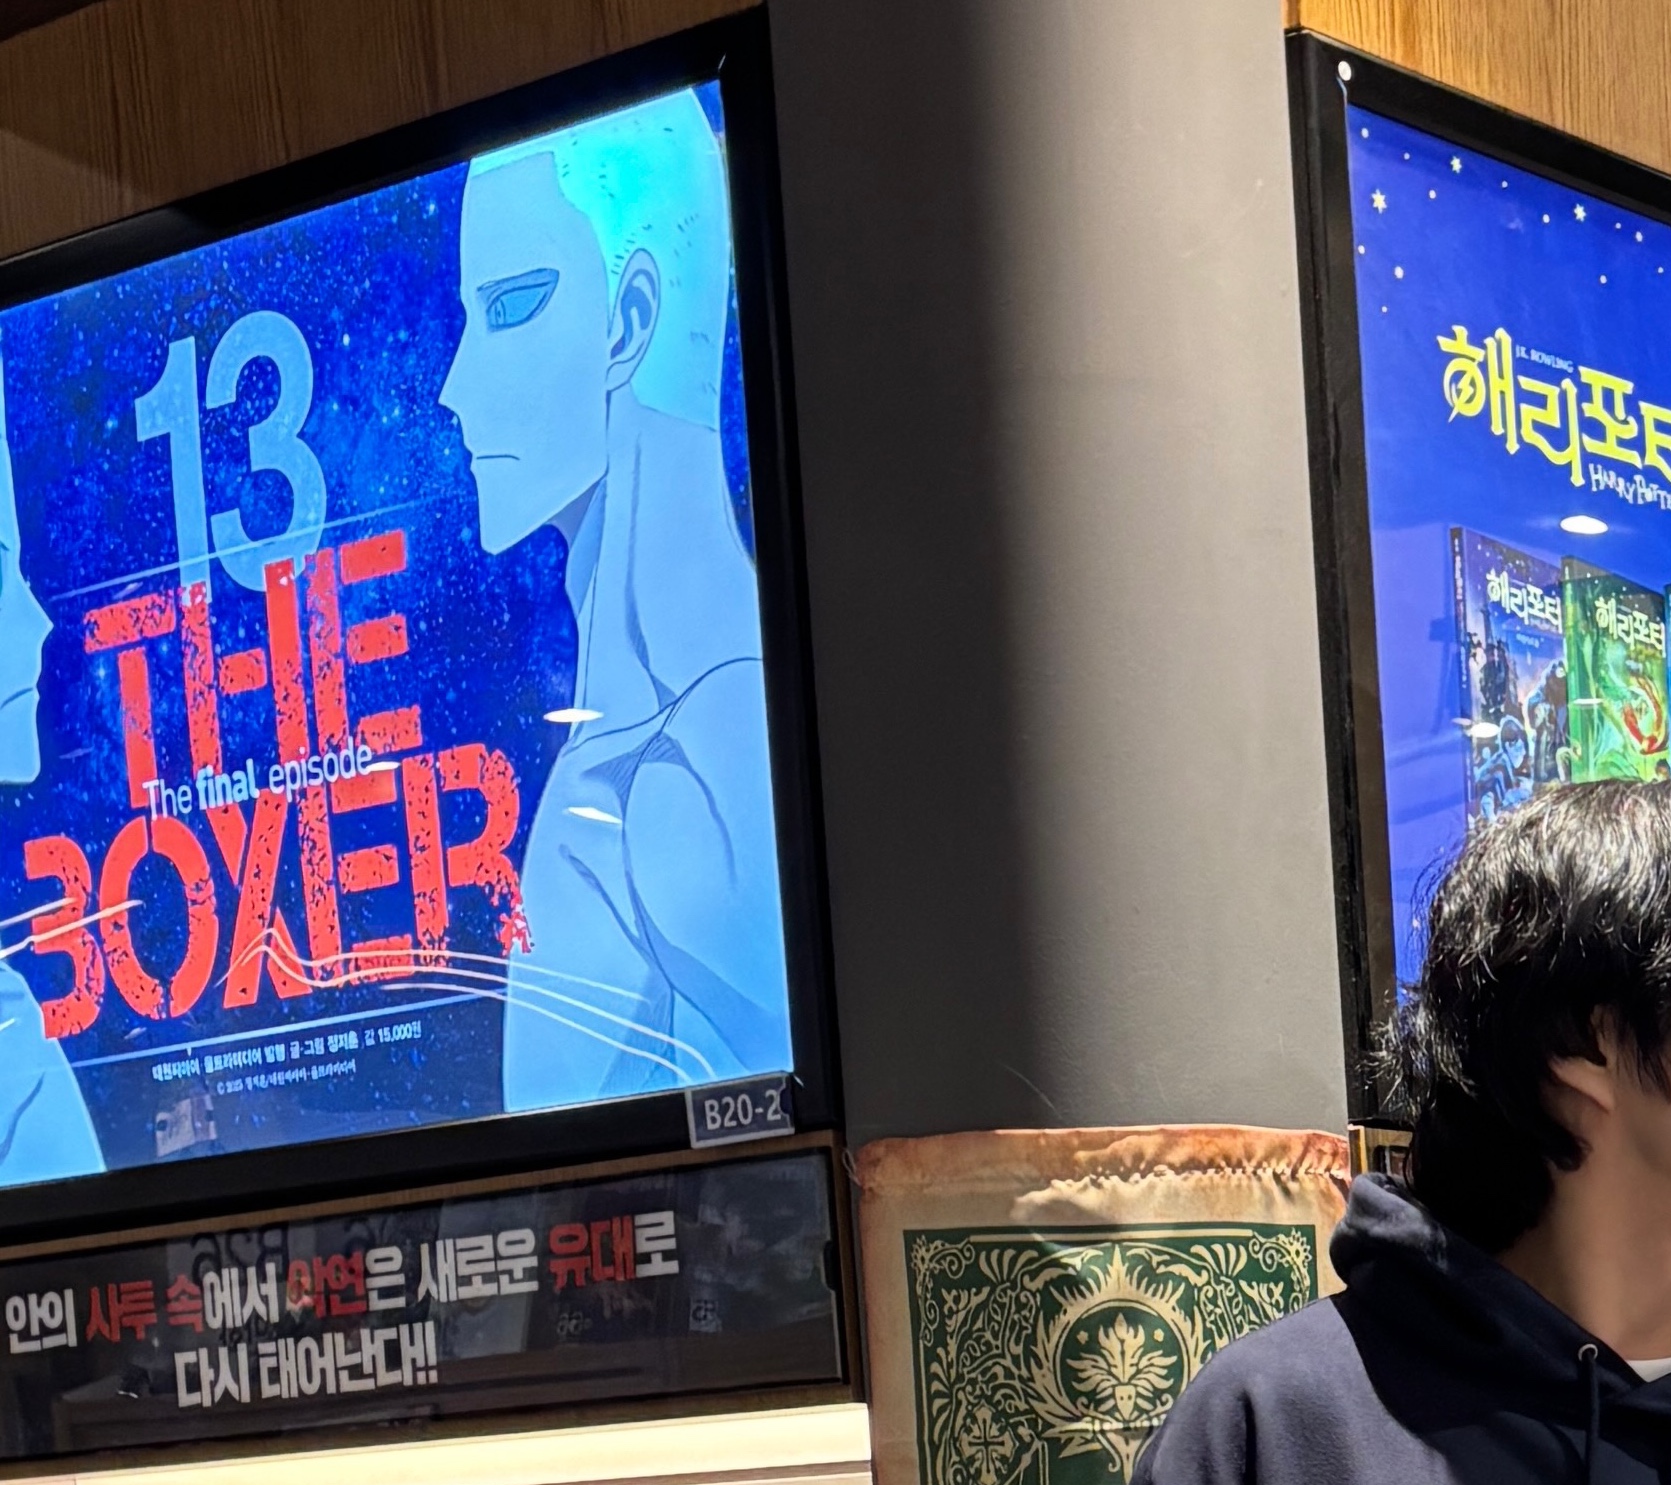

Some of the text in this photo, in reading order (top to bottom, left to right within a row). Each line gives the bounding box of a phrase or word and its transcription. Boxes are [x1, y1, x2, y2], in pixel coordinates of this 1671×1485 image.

[134, 310, 327, 604] 13
[1589, 463, 1635, 505] HARRY
[84, 530, 422, 812] THE
[143, 735, 374, 821] The final episode
[703, 1089, 783, 1132] B20-2
[5, 1210, 681, 1355] 안의 사투 속에서 악연은 새로운 유대로
[174, 1322, 440, 1411] 다시 태어난다!!
